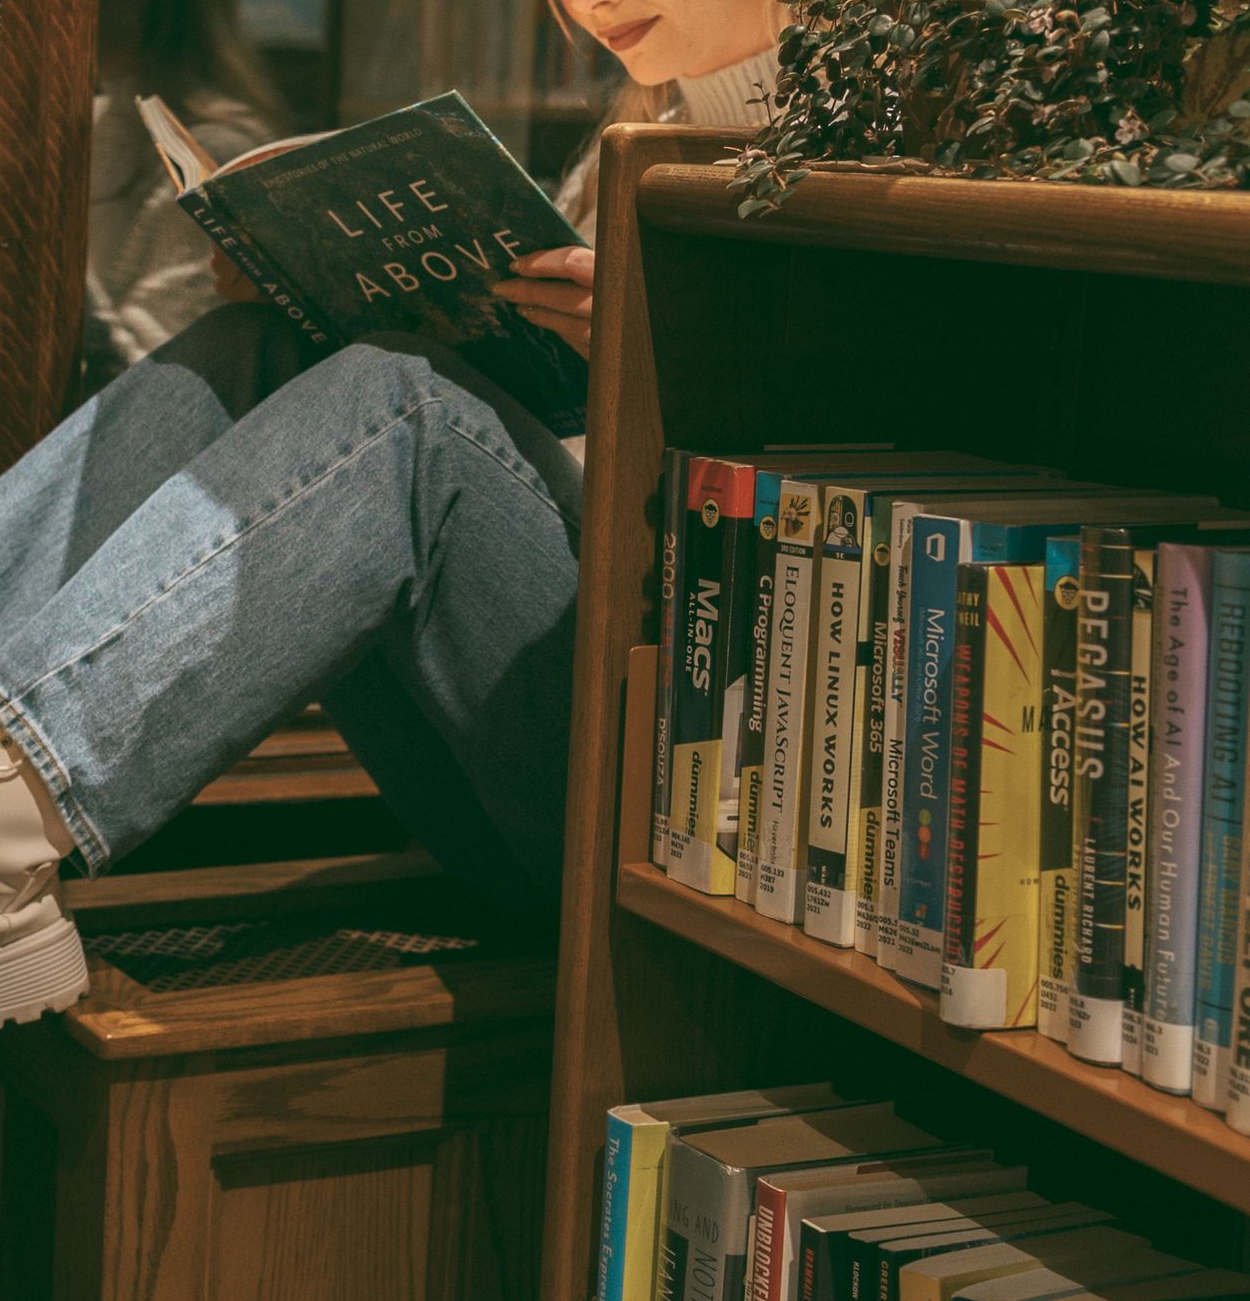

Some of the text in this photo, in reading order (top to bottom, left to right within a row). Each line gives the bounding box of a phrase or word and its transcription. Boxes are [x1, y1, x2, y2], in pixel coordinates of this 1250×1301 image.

[387, 127, 423, 147] WORLD
[327, 179, 448, 238] LIFE
[381, 224, 443, 251] FROM
[193, 208, 238, 249] LIFE
[263, 281, 327, 344] ABOVE
[355, 229, 521, 303] ABOVE
[662, 533, 677, 599] 2000
[686, 592, 696, 672] ALL-IN-ONE
[693, 579, 720, 690] Macs
[749, 575, 773, 733] C Programming
[772, 564, 801, 814] ELOQUENT JAVASCRIPT
[820, 583, 845, 829] HOW LINUX WORKS
[869, 621, 888, 754] Microsoft 365
[919, 608, 946, 801] Microsoft Word
[953, 644, 972, 739] WEAPONS
[1212, 602, 1246, 805] REBOOTING AI
[951, 748, 968, 770] OF
[1050, 685, 1077, 805] Access
[687, 751, 703, 838] dummies
[883, 738, 903, 887] Microsoft Teams
[948, 778, 968, 830] MATH
[1128, 676, 1146, 912] HOW AI WORKS
[1155, 588, 1188, 1021] The Age of AI And Our Human Future
[1053, 874, 1070, 980] dummies
[1080, 837, 1097, 964] LAURENT RICHARD
[608, 1137, 620, 1166] The
[602, 1170, 617, 1240] Socrates
[694, 1215, 720, 1244] AND
[851, 1261, 860, 1301] KLOCKOW
[880, 1260, 890, 1301] GREER
